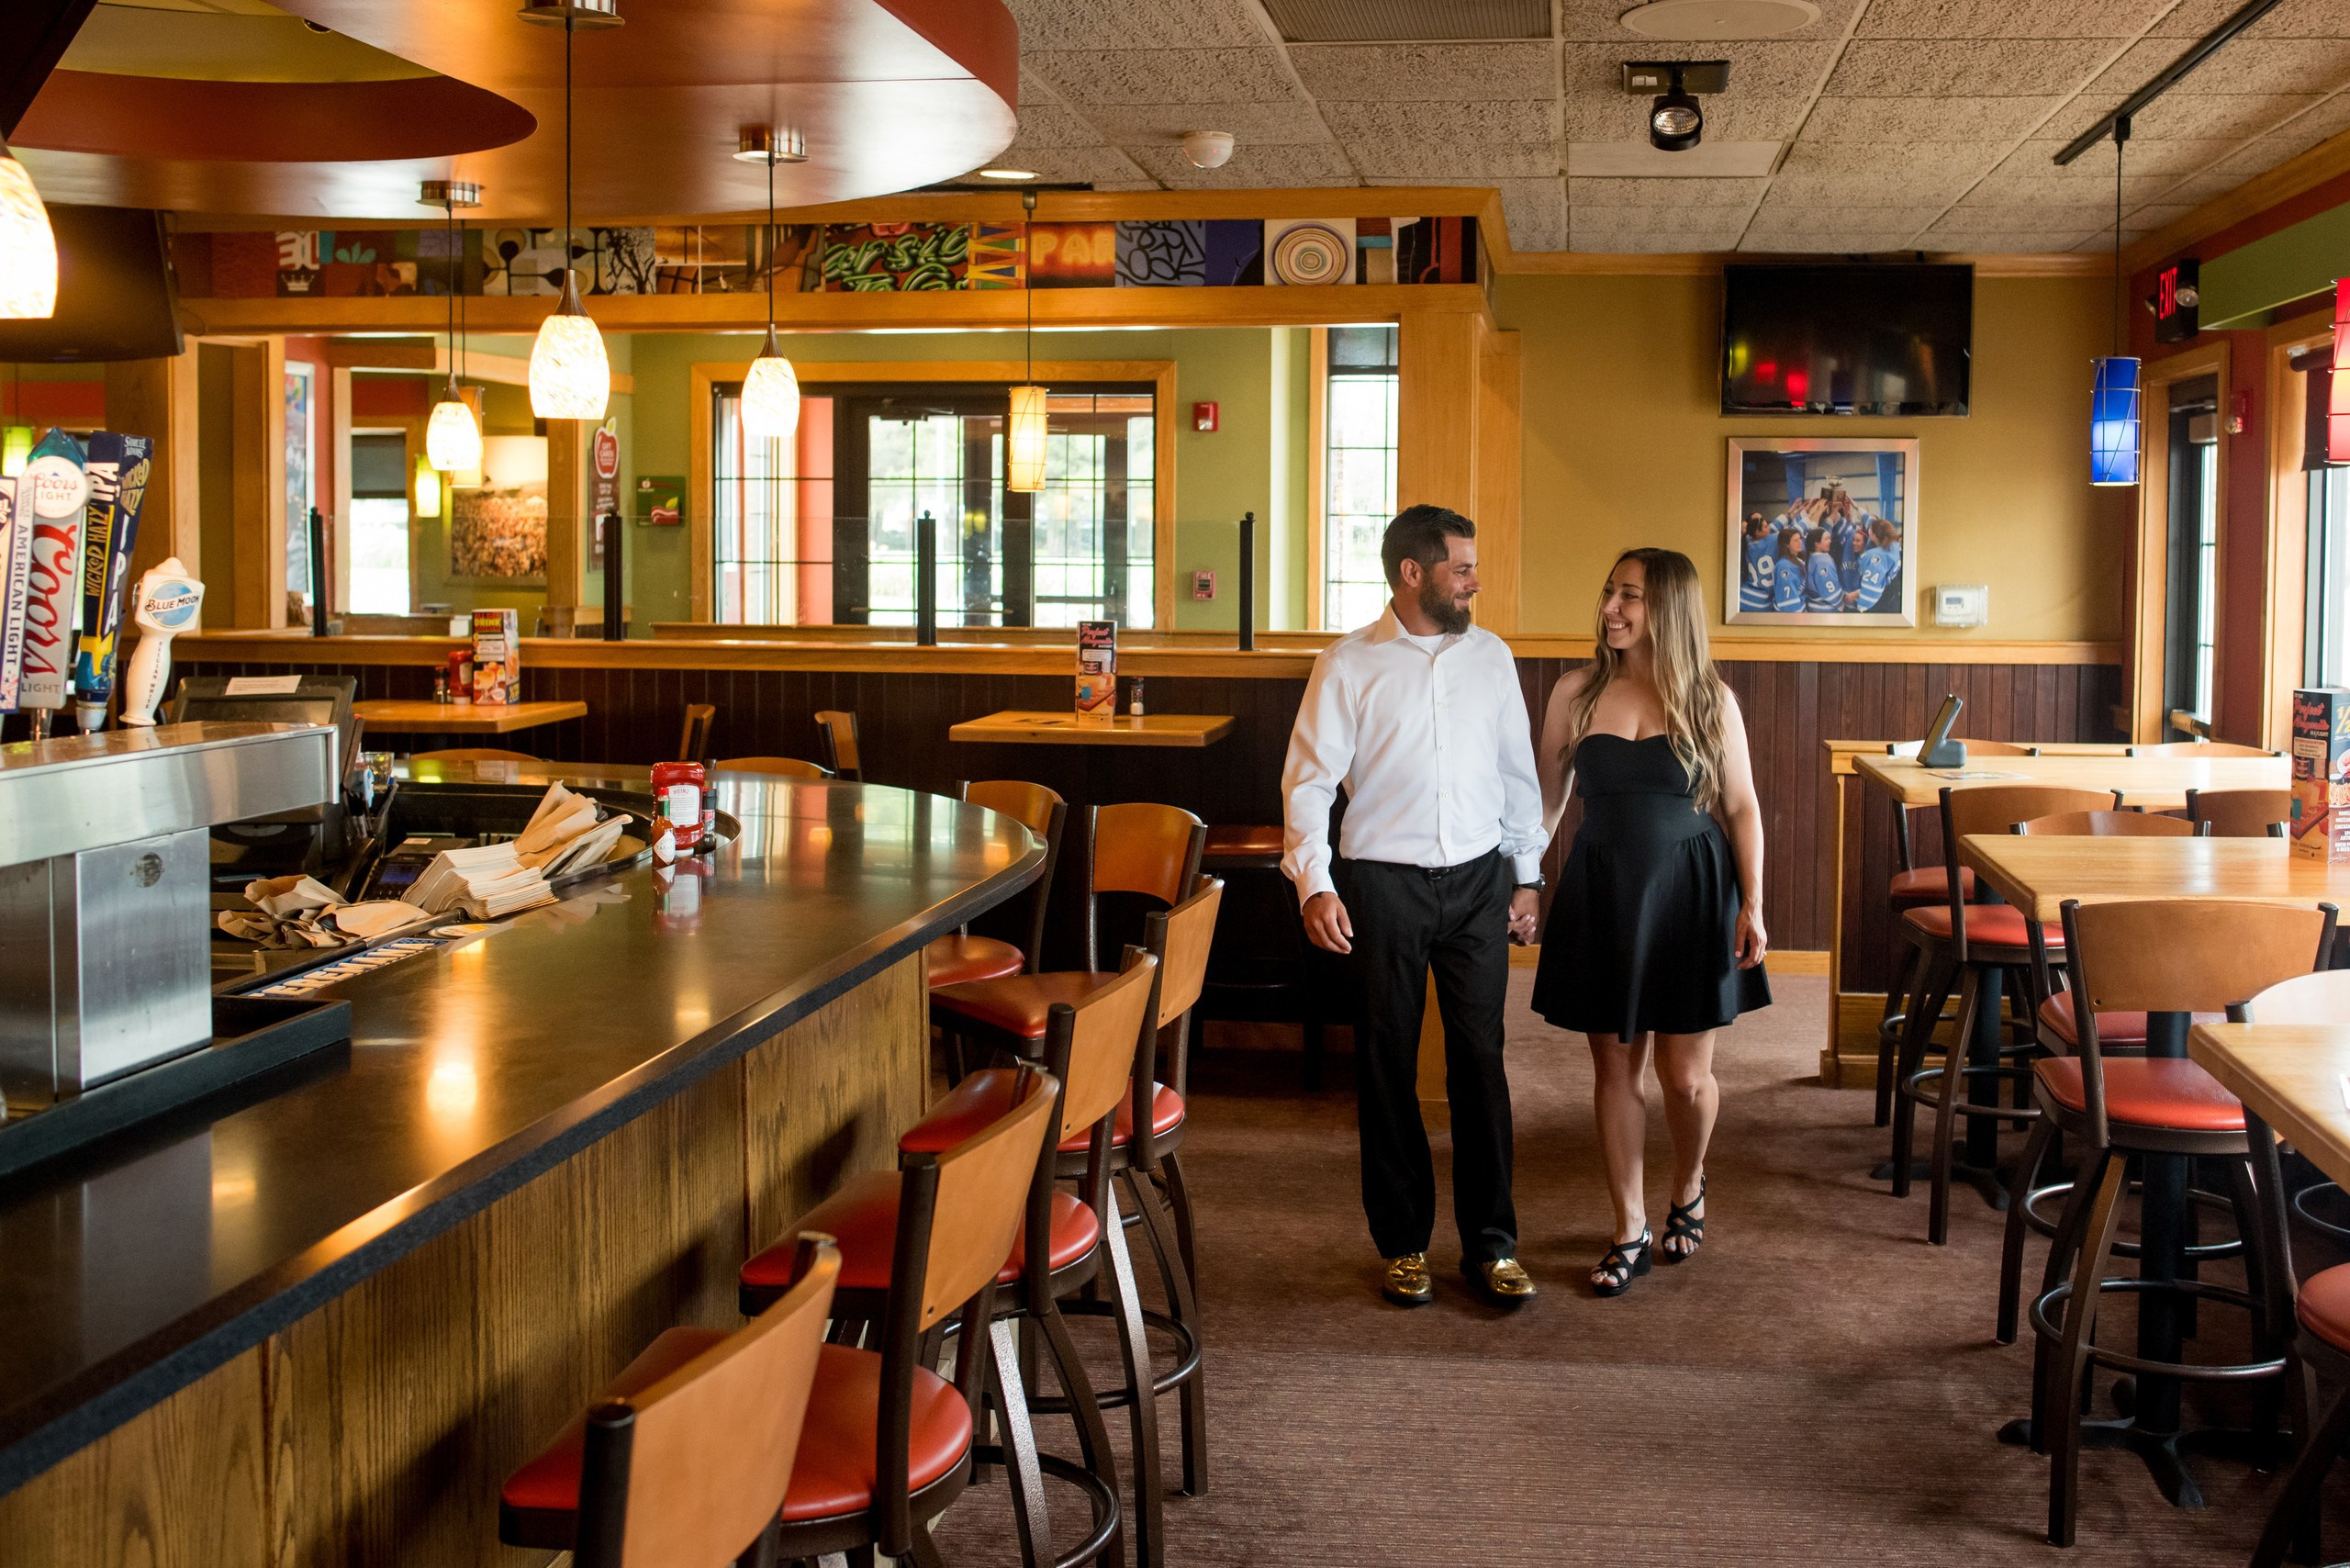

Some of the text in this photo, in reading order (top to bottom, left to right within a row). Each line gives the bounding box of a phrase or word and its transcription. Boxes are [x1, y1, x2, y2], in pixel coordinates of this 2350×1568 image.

[2159, 266, 2178, 319] EXIT
[35, 492, 73, 500] IGHT
[87, 505, 109, 543] HAZY
[1748, 554, 1775, 588] 19
[1863, 569, 1880, 585] 24
[6, 524, 29, 666] AMERICAN LIGHT
[1784, 586, 1791, 599] 7
[1825, 580, 1836, 593] 9
[22, 524, 77, 679] Coors
[145, 594, 200, 612] BLUE MOON
[21, 682, 62, 695] LIGHT
[248, 942, 436, 998] EREMANA
